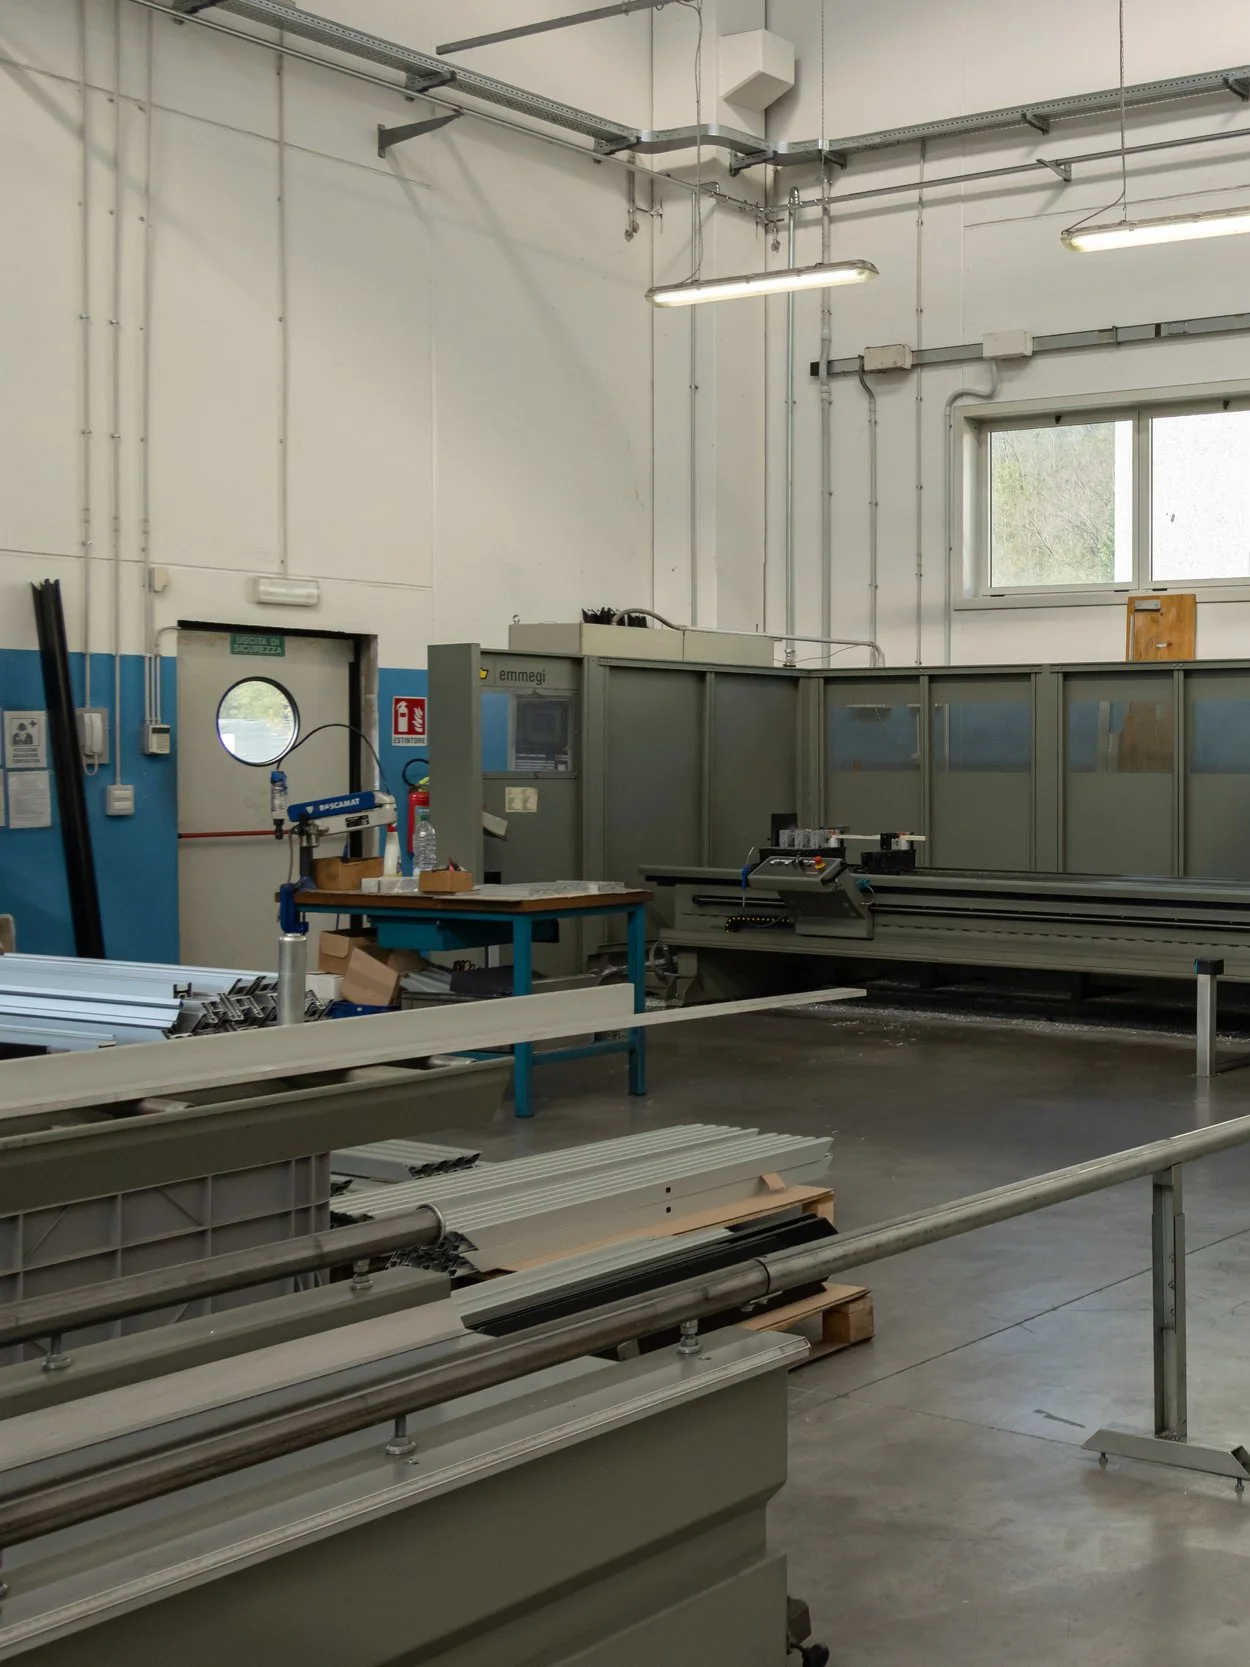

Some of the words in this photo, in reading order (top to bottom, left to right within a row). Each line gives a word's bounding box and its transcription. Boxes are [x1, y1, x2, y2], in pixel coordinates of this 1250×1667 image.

[236, 635, 267, 645] USCITA
[270, 638, 280, 646] DI
[233, 644, 282, 654] SICUREZZA
[499, 669, 546, 686] emmegi
[393, 736, 426, 745] ESTINTORE
